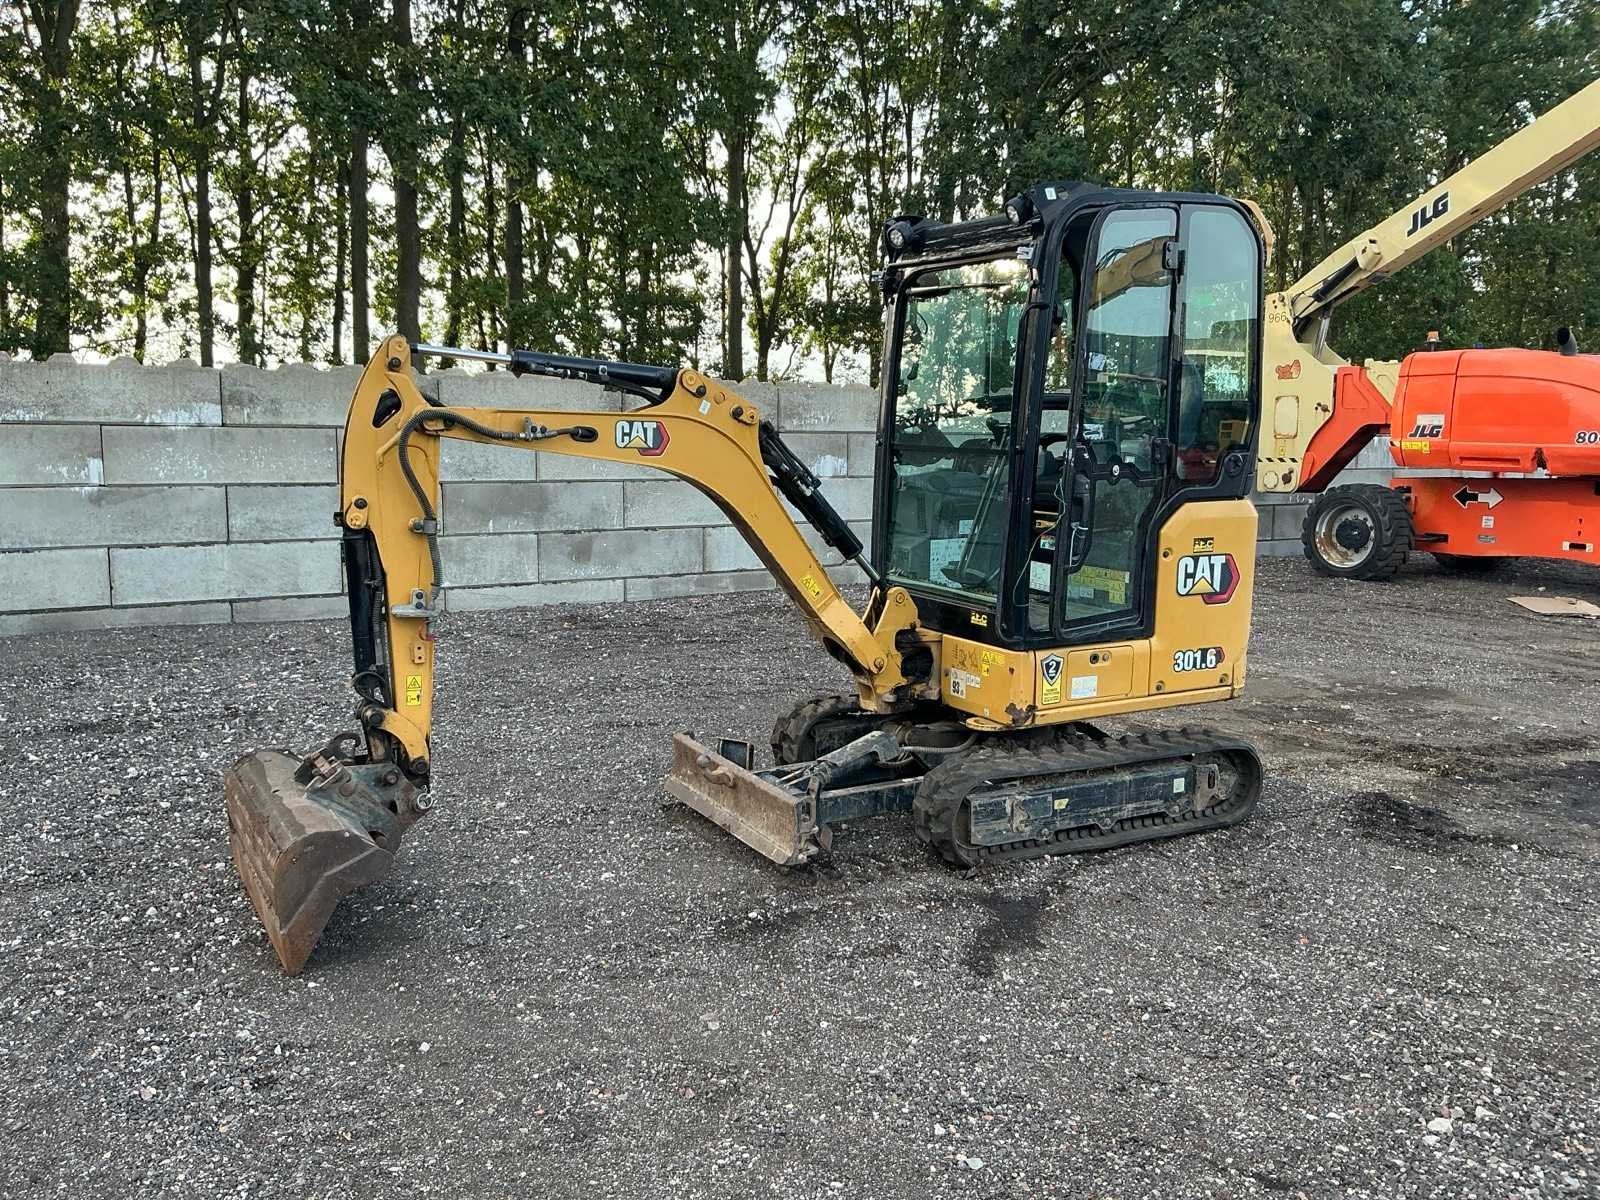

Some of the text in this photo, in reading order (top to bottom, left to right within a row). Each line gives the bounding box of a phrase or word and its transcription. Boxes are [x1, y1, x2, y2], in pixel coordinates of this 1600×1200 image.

[1407, 191, 1449, 238] JLG
[1268, 311, 1287, 323] 966
[616, 420, 657, 448] CAT
[1408, 424, 1444, 438] JLG
[1575, 431, 1600, 444] 80
[1177, 555, 1226, 595] CAT
[1049, 660, 1057, 673] 2
[1174, 648, 1217, 672] 301.6
[952, 680, 960, 695] 93
